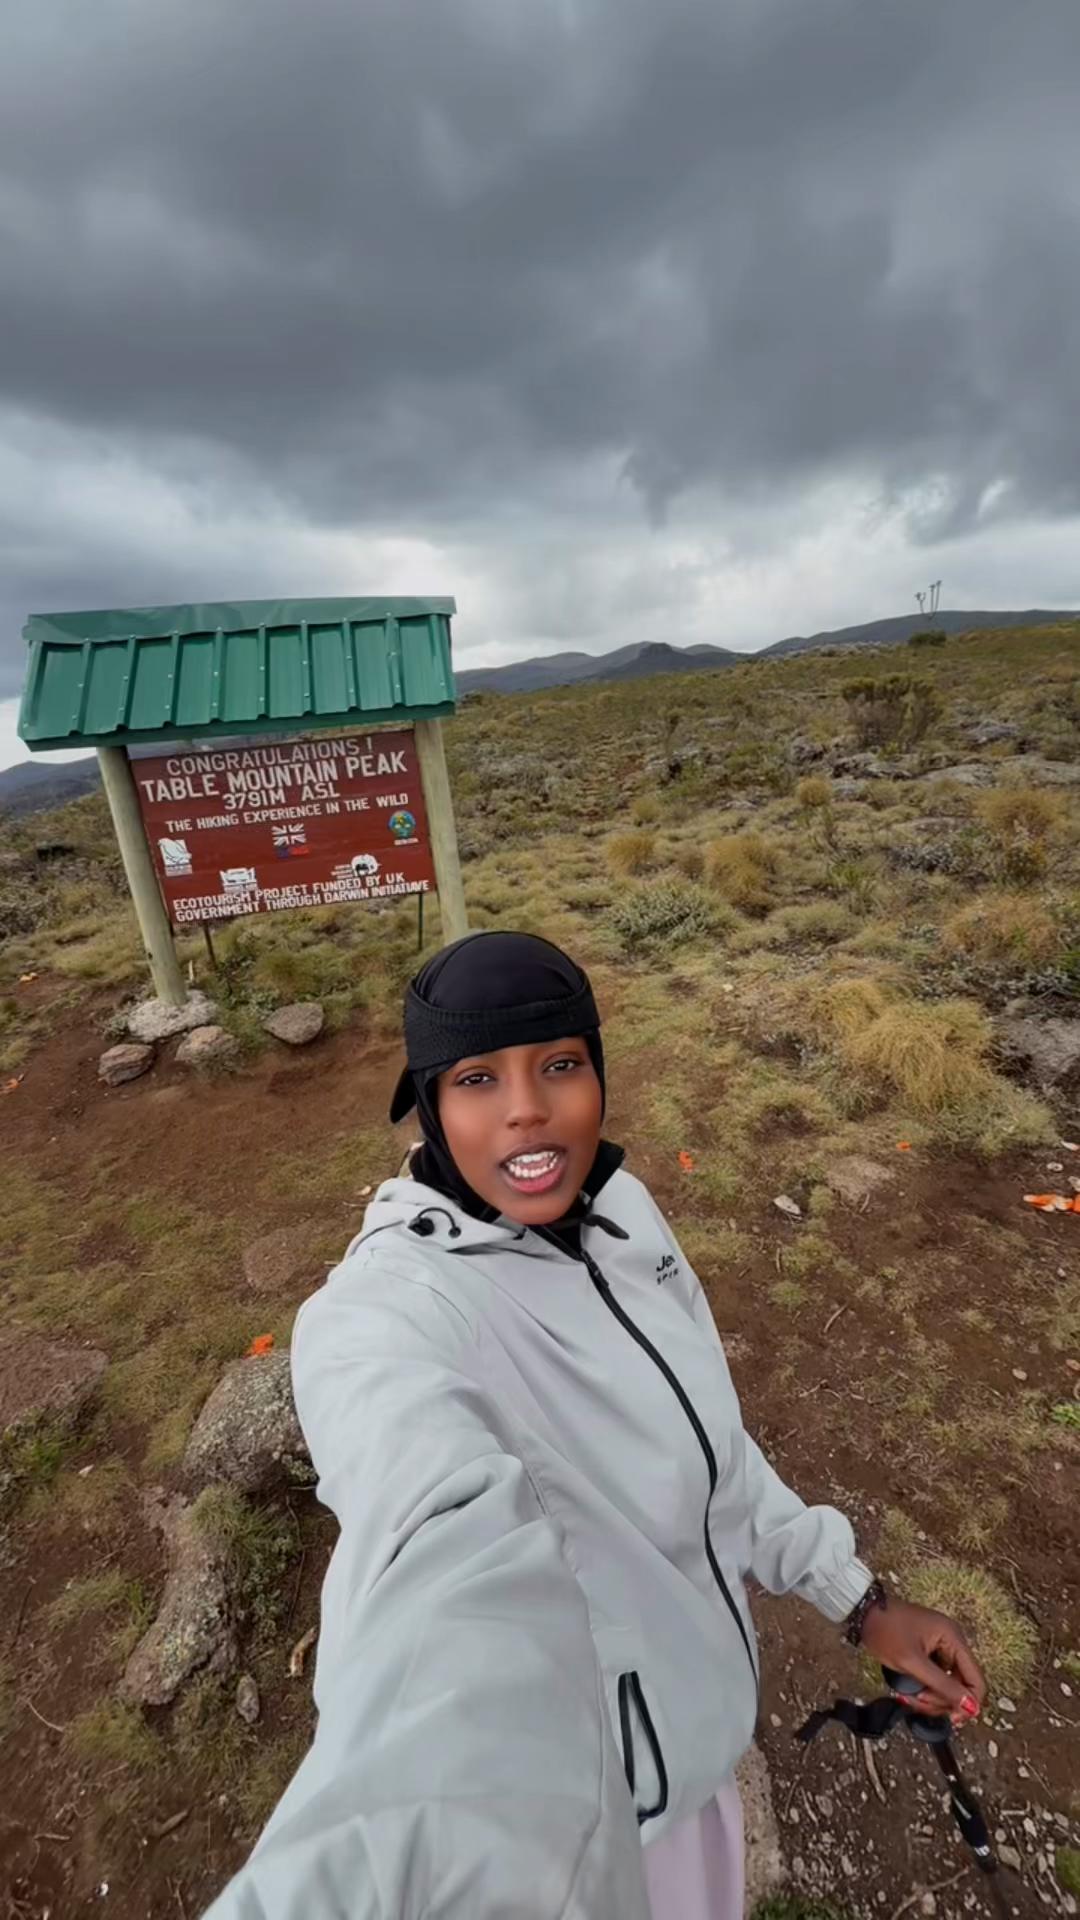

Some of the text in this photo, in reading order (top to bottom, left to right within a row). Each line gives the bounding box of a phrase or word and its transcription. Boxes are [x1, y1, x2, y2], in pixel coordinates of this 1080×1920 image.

[140, 750, 408, 803] TABLE MOUNTAIN PEAK
[166, 738, 360, 776] CONGRATULATIONS
[165, 792, 409, 833] THE HIKING EXPERIENCE IN THE WILD
[222, 781, 340, 811] 3791M ASL
[172, 890, 252, 911] ECOTOURISM
[255, 883, 308, 902] PROJECT
[312, 877, 362, 894] FUNDED
[365, 874, 381, 888] BY
[385, 871, 406, 885] UK
[175, 900, 260, 922] GOVERNMENT
[266, 893, 322, 911] THROUGH
[324, 887, 370, 905] DARWIN
